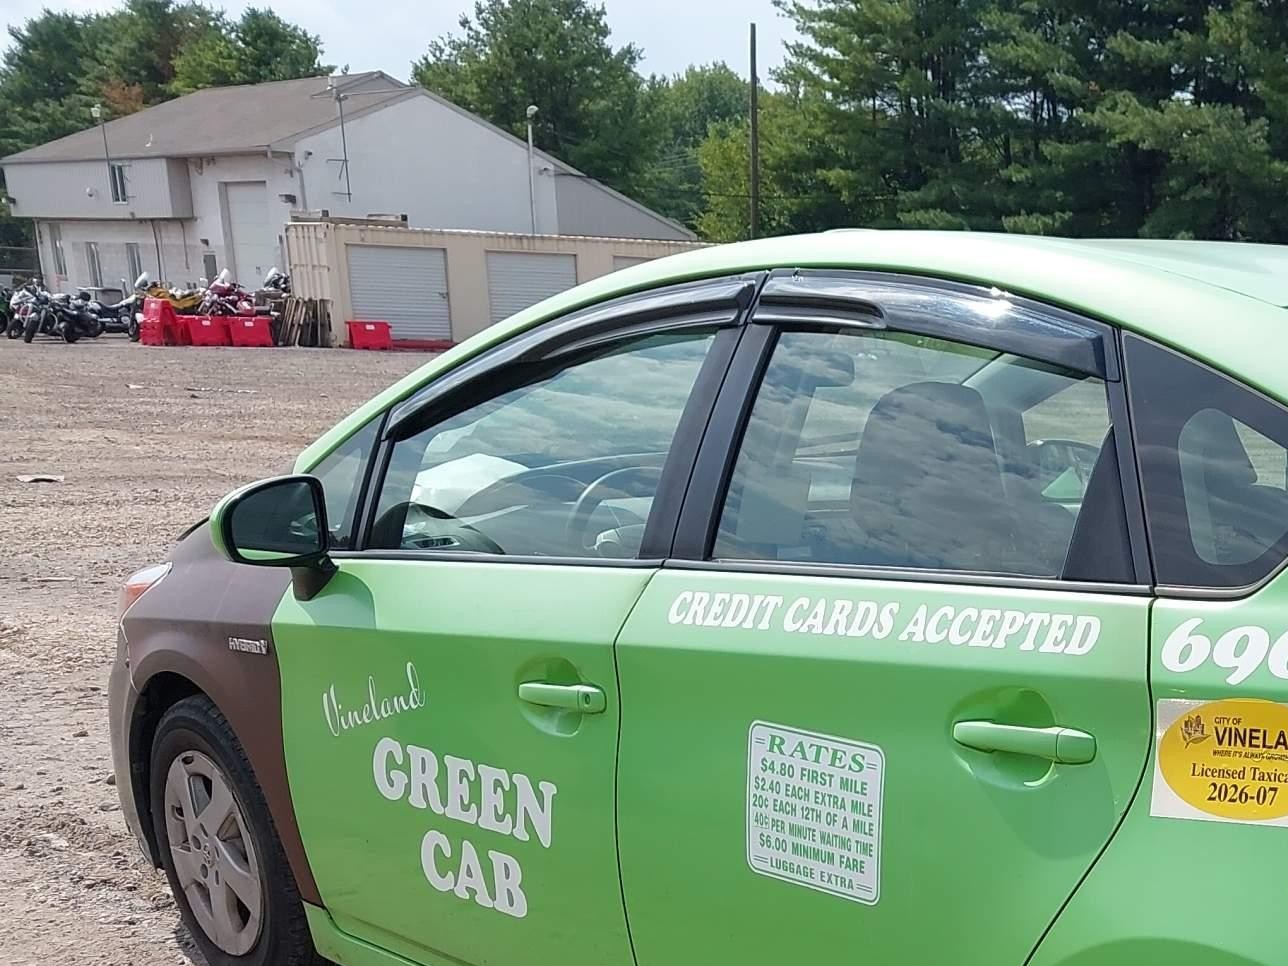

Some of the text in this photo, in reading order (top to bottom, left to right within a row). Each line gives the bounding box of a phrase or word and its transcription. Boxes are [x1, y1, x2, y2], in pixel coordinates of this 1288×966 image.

[667, 591, 1101, 656] CREDIT CARDS ACCEPTED
[321, 661, 426, 737] Vineland
[1214, 716, 1242, 726] CITY OF
[767, 734, 865, 773] RATES
[1191, 763, 1246, 780] Licensed
[373, 736, 557, 848] GREEN
[761, 757, 868, 796] $4.80 FIRST MILE
[1207, 782, 1279, 807] 2026-07
[754, 776, 873, 818] $2.40 EACH EXTRA MILE
[771, 818, 786, 835] PER
[788, 822, 816, 842] MINUTE
[819, 830, 852, 852] WAITING
[855, 840, 873, 858] TIME
[773, 800, 797, 817] EACH
[801, 806, 822, 824] 12TH
[825, 812, 838, 828] OF
[841, 816, 848, 830] A
[852, 818, 874, 837] MILE
[759, 832, 865, 875] $6.00 MINIMUM FARE
[421, 830, 528, 918] CAB
[770, 856, 854, 891] LUGGAGE EXTRA
